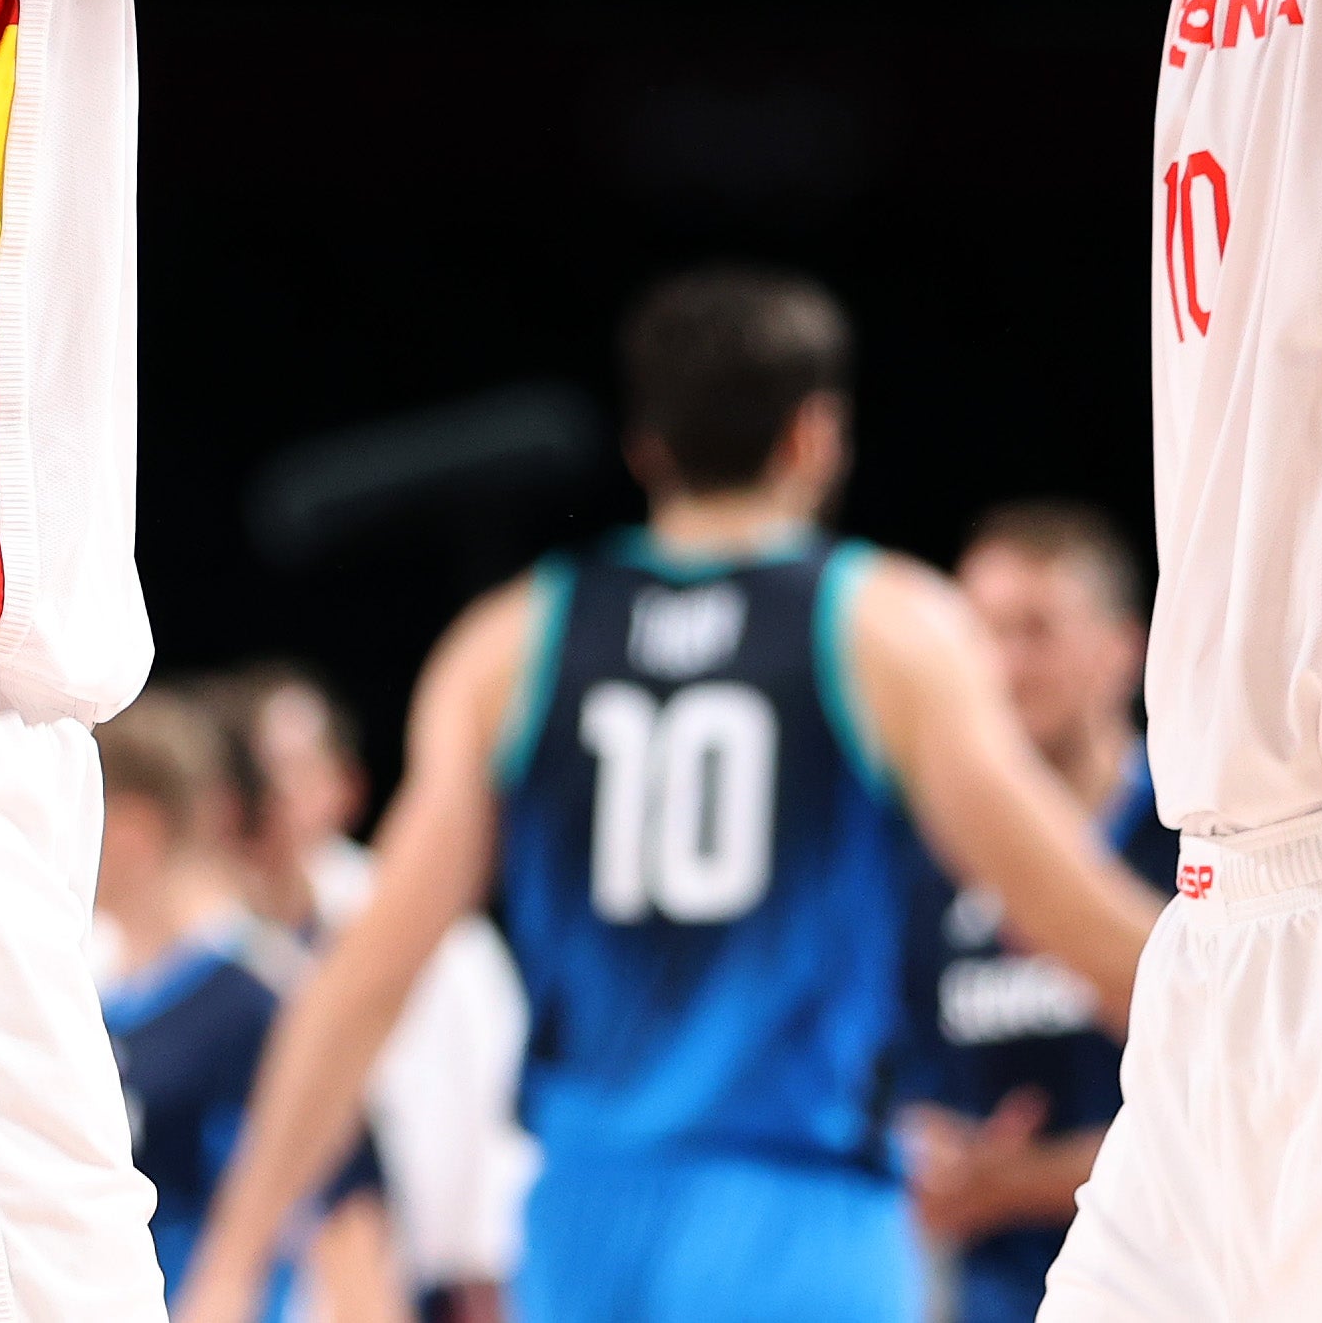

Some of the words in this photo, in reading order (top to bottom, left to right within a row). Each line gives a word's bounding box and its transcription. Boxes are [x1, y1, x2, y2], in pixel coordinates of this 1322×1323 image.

[1163, 148, 1231, 343] 10
[579, 680, 776, 923] 10
[1179, 865, 1214, 900] SP
